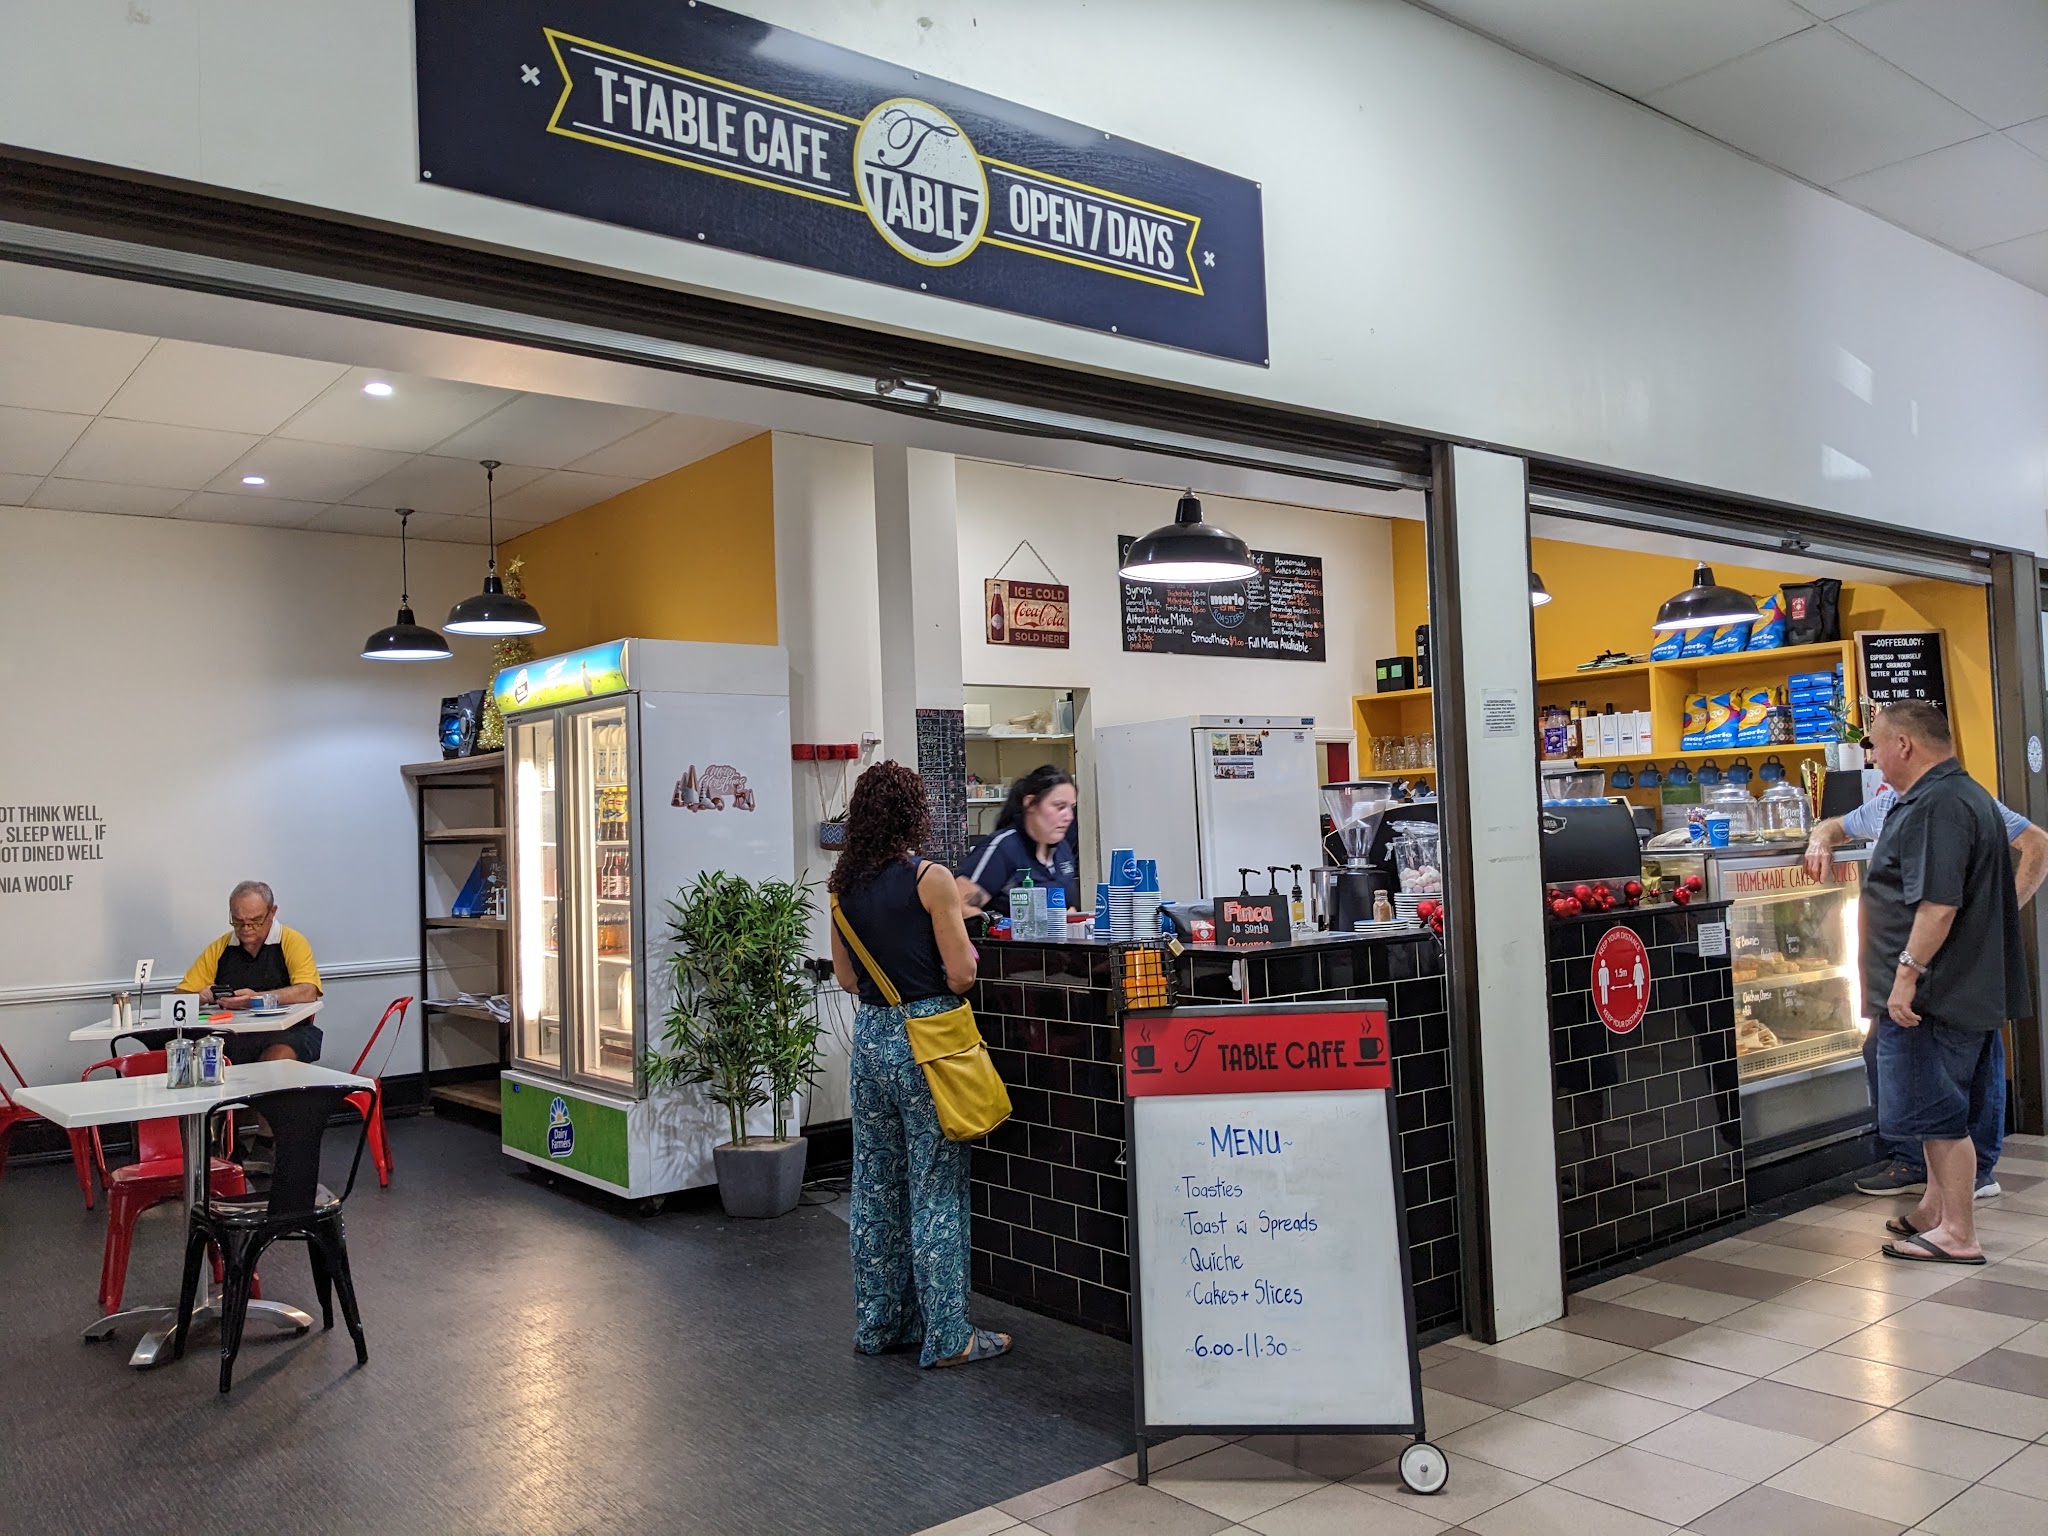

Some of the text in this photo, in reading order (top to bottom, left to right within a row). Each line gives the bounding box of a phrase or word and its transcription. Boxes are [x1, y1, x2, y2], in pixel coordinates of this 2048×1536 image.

[595, 67, 831, 181] T-TABLE CAFE
[877, 108, 960, 168] T
[864, 171, 979, 242] TABLE
[1009, 184, 1175, 270] OPEN 7 DAYS
[1014, 586, 1065, 600] ICE COLD
[1125, 584, 1152, 601] Syrups
[1210, 593, 1244, 606] merlo
[1126, 613, 1193, 626] Alternative Milks
[1212, 609, 1244, 625] ROASTERS
[1015, 632, 1065, 644] SOLD HERE
[1191, 631, 1229, 646] Smoothies
[1229, 634, 1245, 647] $9.00
[1248, 636, 1260, 649] Full
[1261, 637, 1279, 649] Menu
[1872, 689, 1925, 698] TAKE TIME TO
[1694, 712, 1706, 722] 30
[1711, 708, 1724, 719] 30
[1748, 708, 1761, 718] 30
[1704, 732, 1732, 740] merlo
[1738, 728, 1766, 738] merlo
[18, 806, 61, 822] THINK
[63, 805, 103, 822] WELL,
[6, 824, 106, 843] SLEEP WELL, IF
[22, 845, 64, 862] DINED
[67, 844, 103, 861] WELL
[24, 874, 73, 893] WOOLF
[1736, 868, 1786, 893] HOMEMADE
[1789, 867, 1816, 887] CAKE
[1011, 893, 1028, 901] HAND
[1223, 900, 1273, 922] Finca
[1232, 923, 1269, 934] la santa
[1599, 939, 1608, 956] KEEP
[1607, 932, 1620, 943] YOUR
[140, 963, 148, 979] 5
[1614, 967, 1627, 978] 1.5m
[173, 1000, 187, 1022] 6
[1602, 1008, 1614, 1023] KEEP
[1613, 1020, 1625, 1028] YOUR
[1174, 1028, 1348, 1073] T TABLE CAFE
[554, 1129, 568, 1140] Dairy
[551, 1139, 571, 1149] Farmers
[1181, 1175, 1243, 1199] Toasties
[1184, 1211, 1226, 1235] Toast
[1258, 1210, 1318, 1240] Spreads
[1189, 1243, 1244, 1272] Quiche
[1254, 1279, 1304, 1306] Slices
